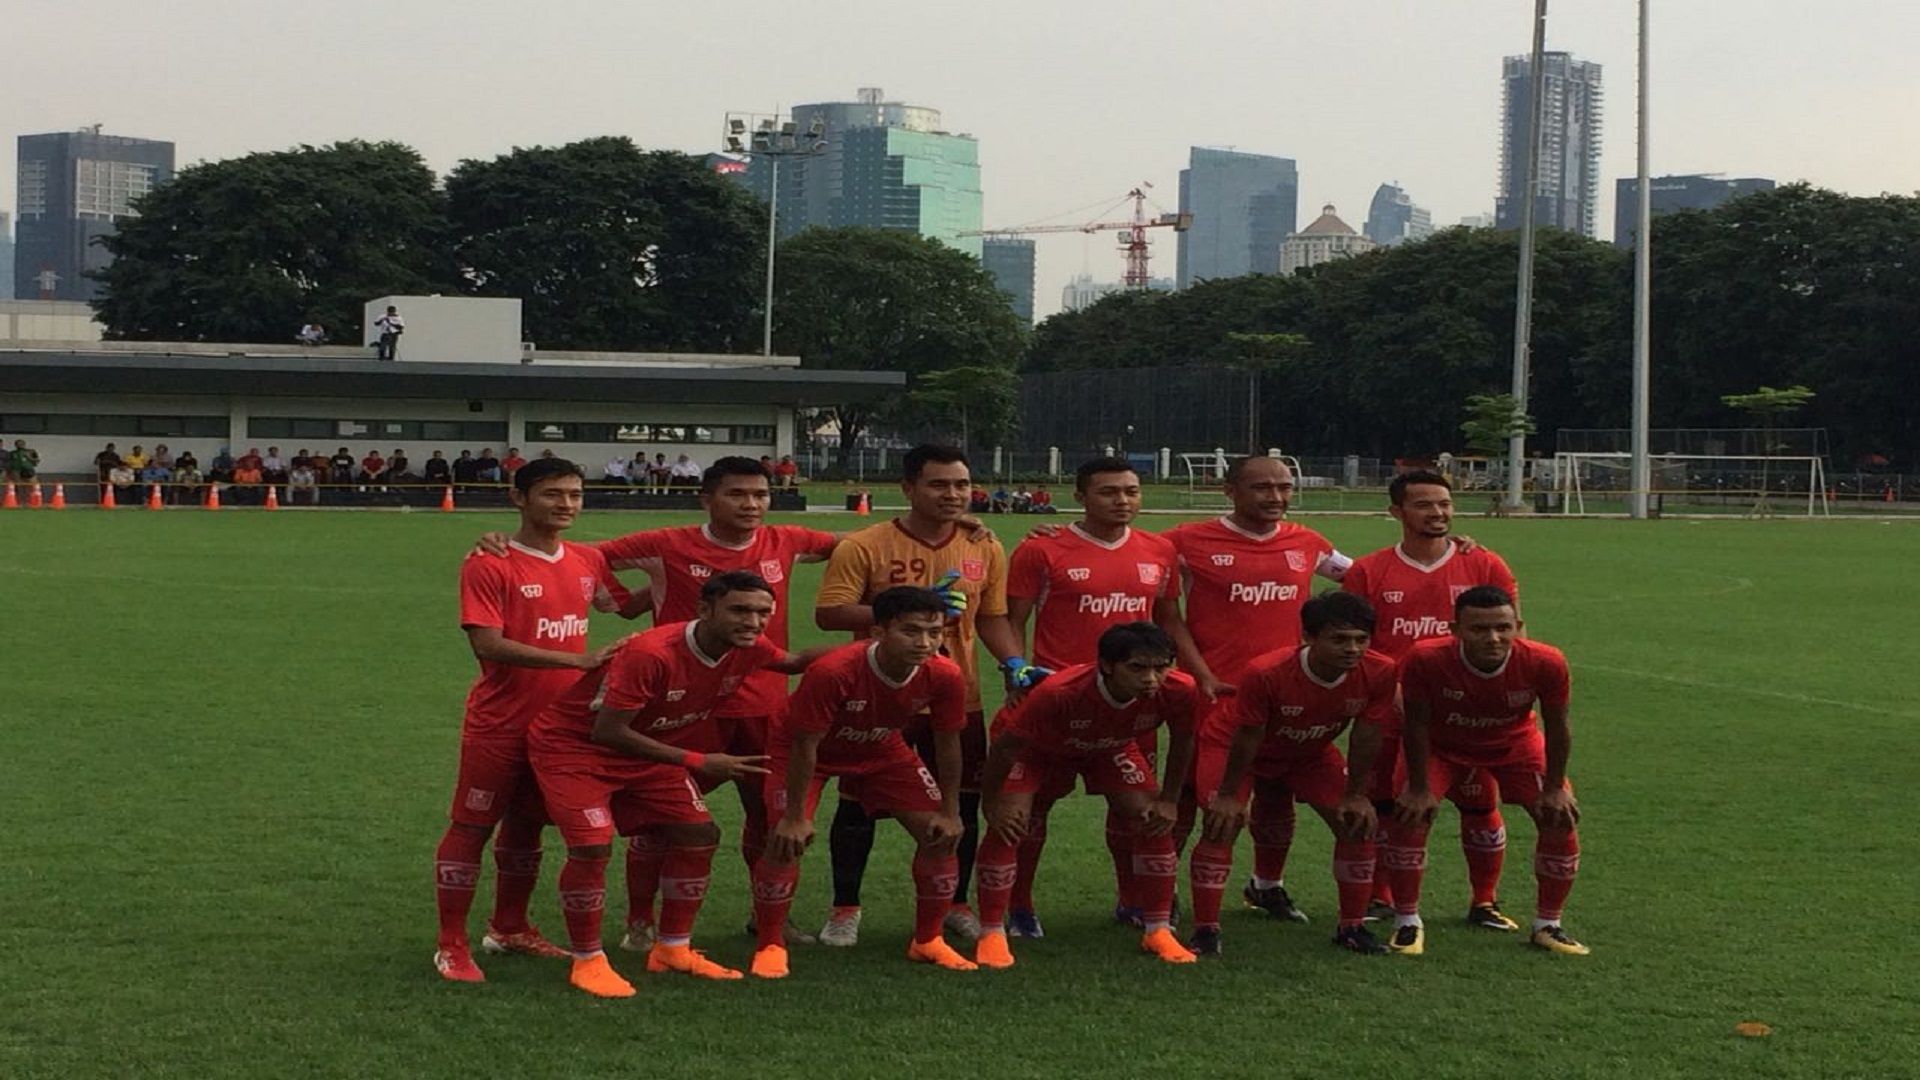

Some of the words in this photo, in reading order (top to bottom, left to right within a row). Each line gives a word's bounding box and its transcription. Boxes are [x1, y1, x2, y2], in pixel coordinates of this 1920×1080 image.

[889, 558, 925, 583] 29
[1078, 592, 1147, 618] PayTren
[1228, 581, 1298, 605] PayTren
[1392, 616, 1452, 640] PayTre
[835, 726, 890, 744] PayTr
[1113, 752, 1137, 774] 5
[917, 766, 937, 788] 8
